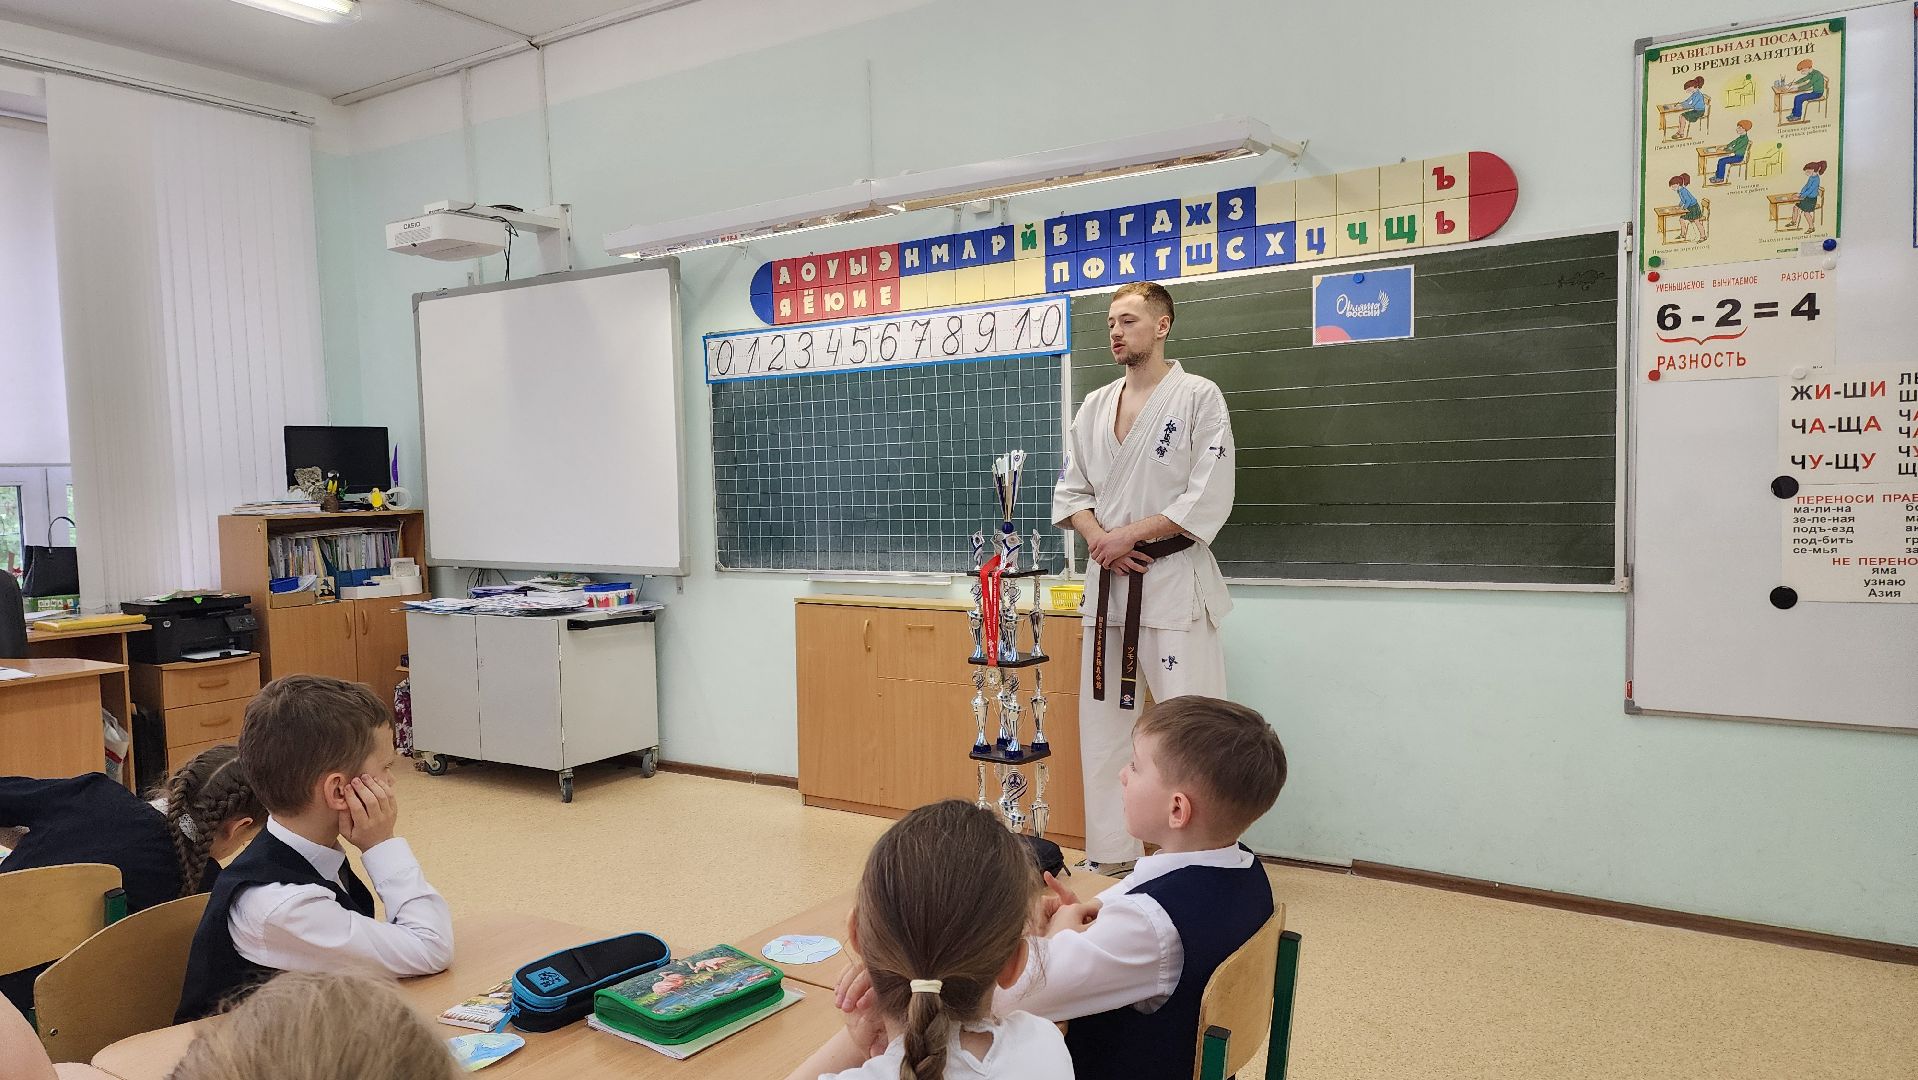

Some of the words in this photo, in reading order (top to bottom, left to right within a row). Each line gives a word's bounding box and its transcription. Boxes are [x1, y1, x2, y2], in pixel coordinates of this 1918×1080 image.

[1659, 38, 1755, 63] ПРАВИЛЬНАЯ
[1760, 27, 1830, 46] ПОСАДКА
[1672, 64, 1690, 75] ВО
[1694, 55, 1741, 72] ВРЕМЯ
[1744, 42, 1816, 63] ЗАНЯТИЙ
[403, 221, 421, 230] CASIO
[1655, 280, 1705, 293] УМЕНЬШАЕМОЕ
[1712, 276, 1758, 288] ВЫЧИТАЕМОЕ
[1781, 270, 1826, 282] РАЗНОСТЬ
[1656, 303, 1682, 331] 6
[1714, 298, 1742, 328] 2
[1790, 292, 1821, 321] 4
[1657, 351, 1747, 371] РАЗНОСТЬ
[1790, 380, 1886, 401] ЖИ-ШИ
[1791, 415, 1882, 435] ЧА-ЩА
[1790, 452, 1876, 472] ЧУ-ЩУ
[1796, 494, 1875, 505] ПЕРЕНОСИ
[1793, 505, 1852, 514] ма-ли-на
[1793, 516, 1855, 524] зе-ле-ная
[1793, 526, 1855, 534] подъ-езд
[1793, 535, 1853, 546] под-бить
[1832, 557, 1851, 566] НЕ
[1871, 567, 1897, 575] яма
[1863, 578, 1906, 588] узнаю
[1867, 588, 1902, 598] Азия
